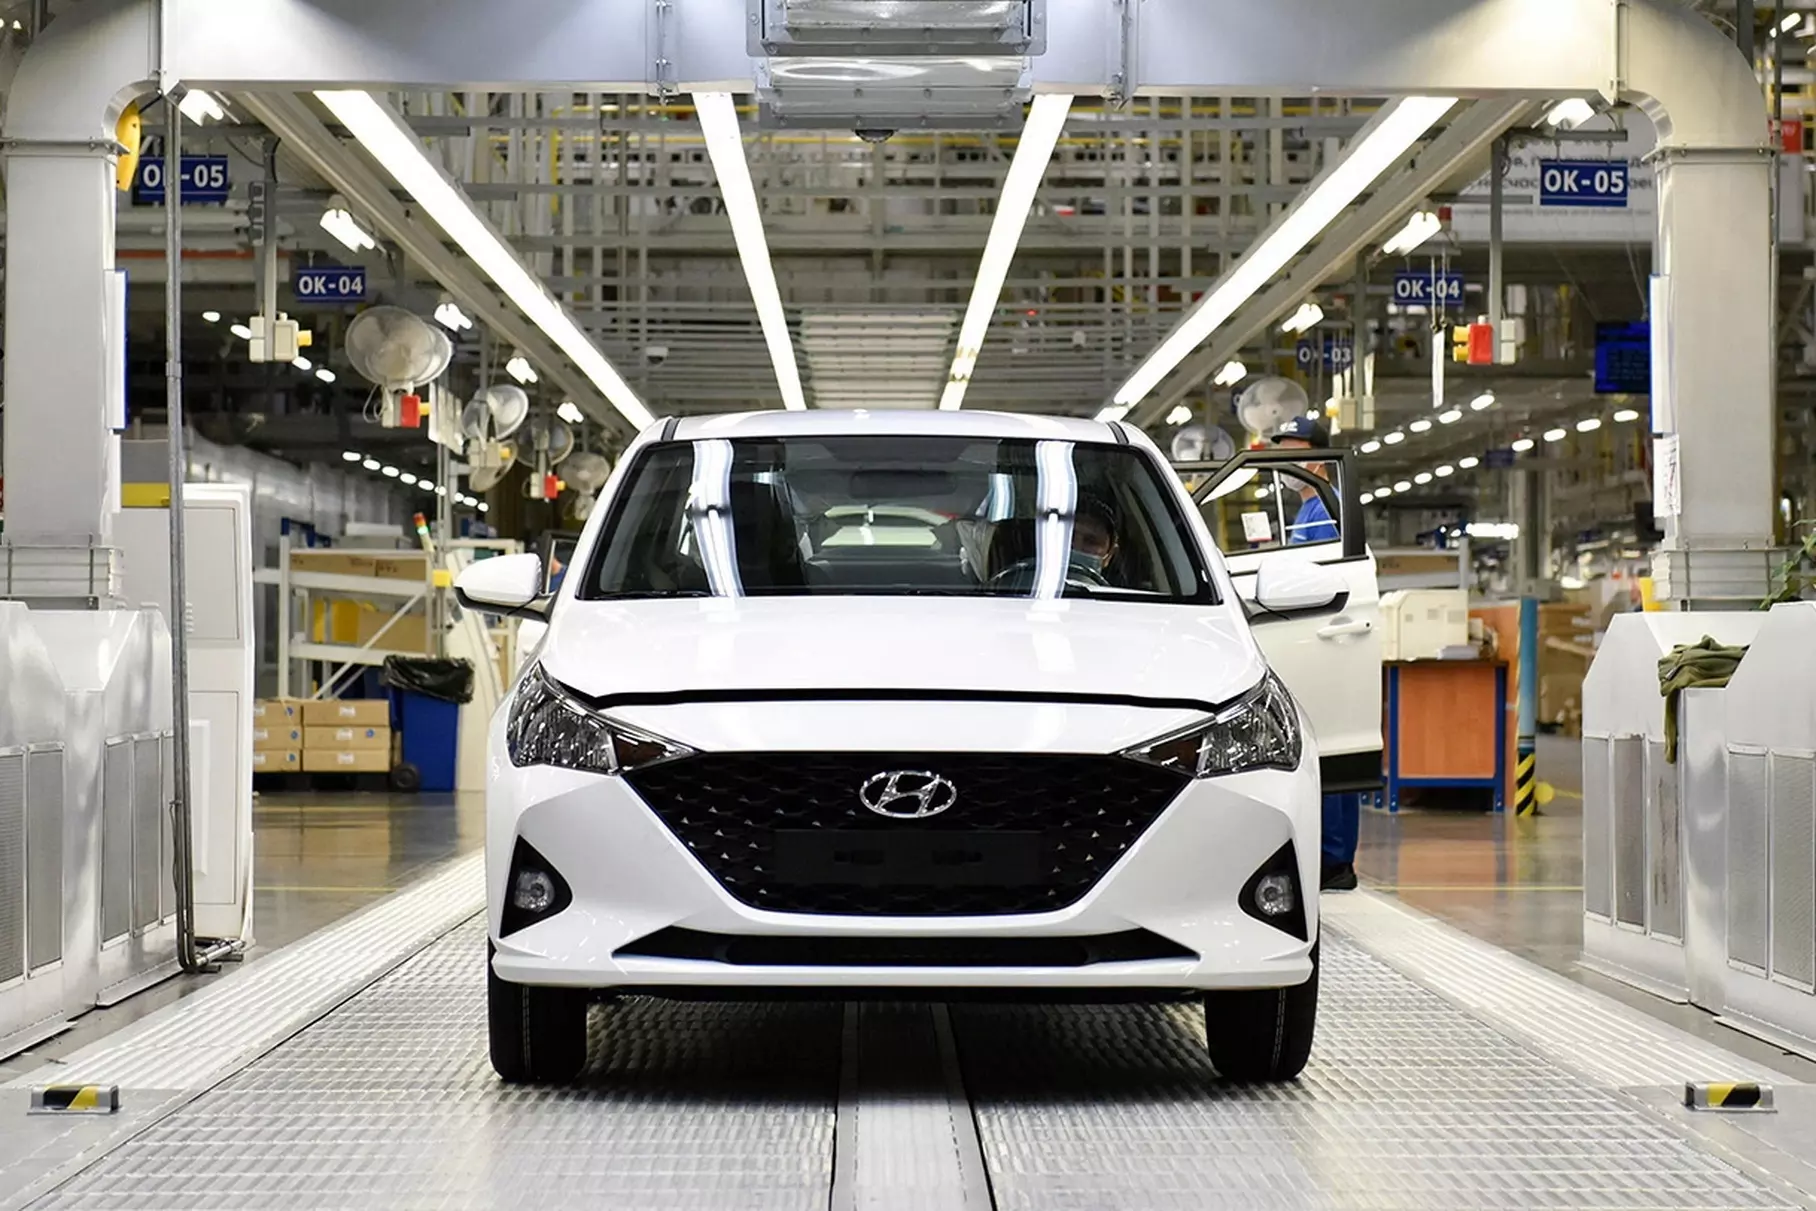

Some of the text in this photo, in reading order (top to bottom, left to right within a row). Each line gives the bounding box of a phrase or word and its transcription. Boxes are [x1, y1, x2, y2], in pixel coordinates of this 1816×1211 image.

[143, 163, 225, 189] O-05
[1543, 169, 1625, 194] OK-05
[298, 276, 364, 295] OK-04
[1396, 279, 1461, 299] OK-04
